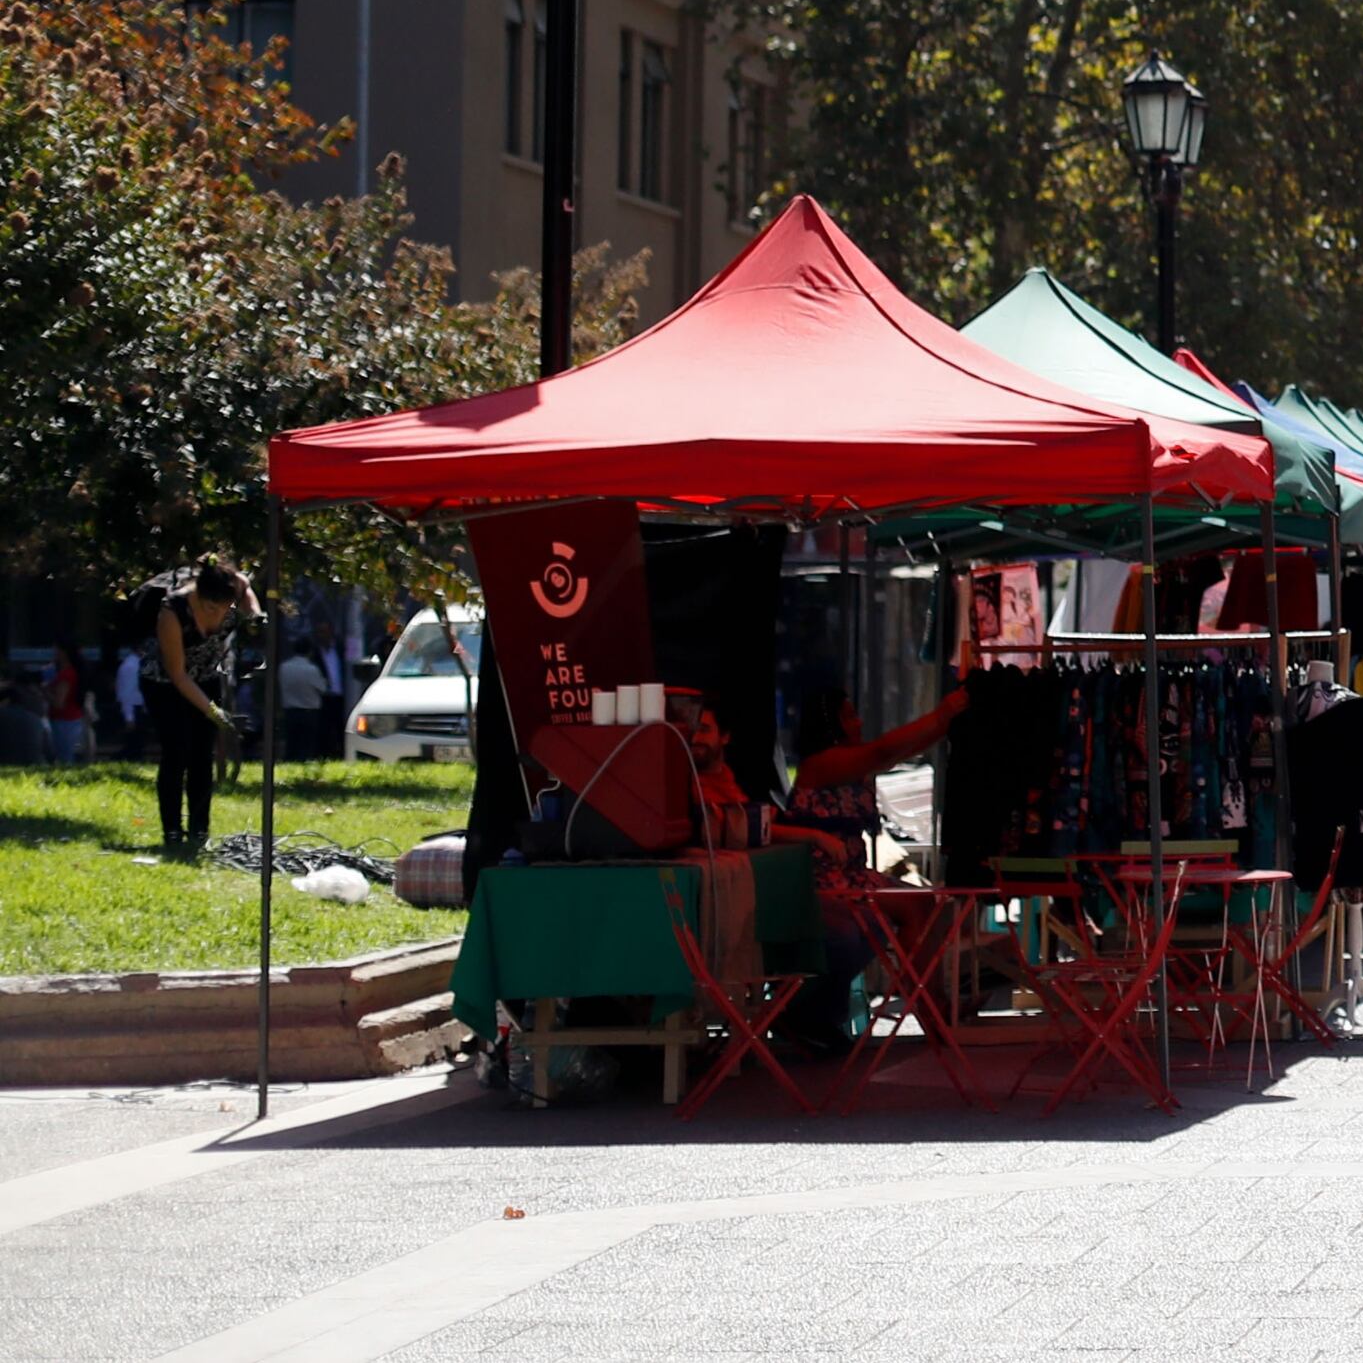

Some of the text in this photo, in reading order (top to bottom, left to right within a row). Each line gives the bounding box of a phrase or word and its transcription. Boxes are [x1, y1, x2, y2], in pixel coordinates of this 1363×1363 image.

[540, 642, 568, 662] WE
[545, 664, 585, 685] ARE
[548, 687, 602, 709] FOU
